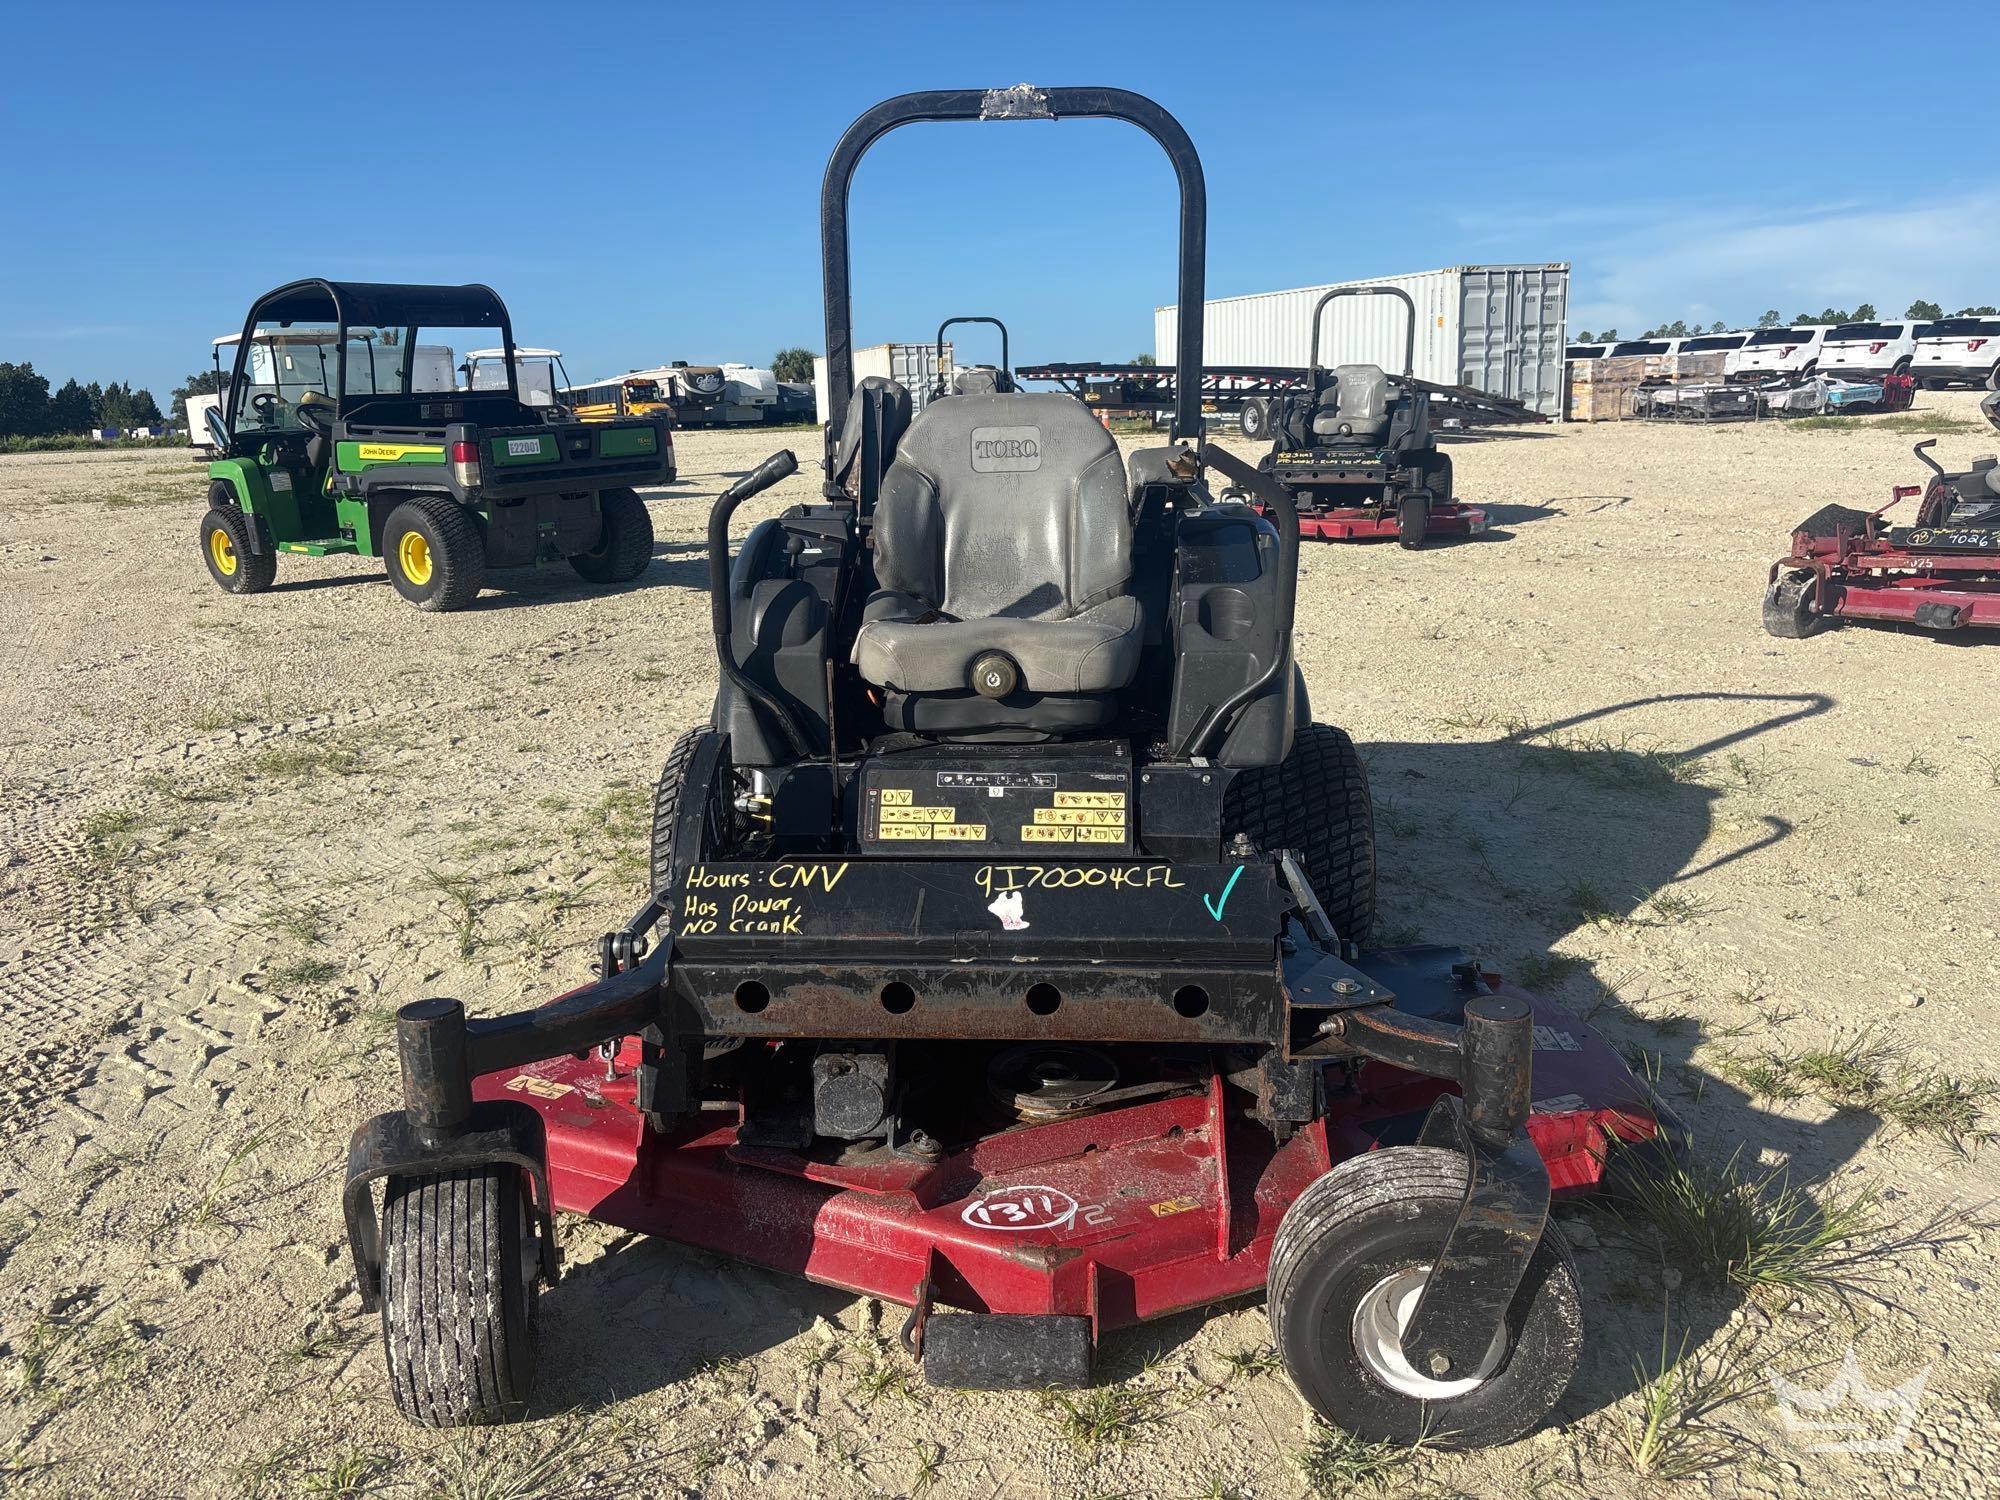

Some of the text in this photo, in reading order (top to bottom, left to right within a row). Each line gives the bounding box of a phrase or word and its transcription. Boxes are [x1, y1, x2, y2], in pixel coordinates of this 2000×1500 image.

[362, 447, 397, 456] JOHN DEERE
[1949, 533, 1988, 548] 4026
[768, 862, 849, 892] CNV
[684, 895, 719, 917] Has
[977, 1195, 1052, 1224] 1311
